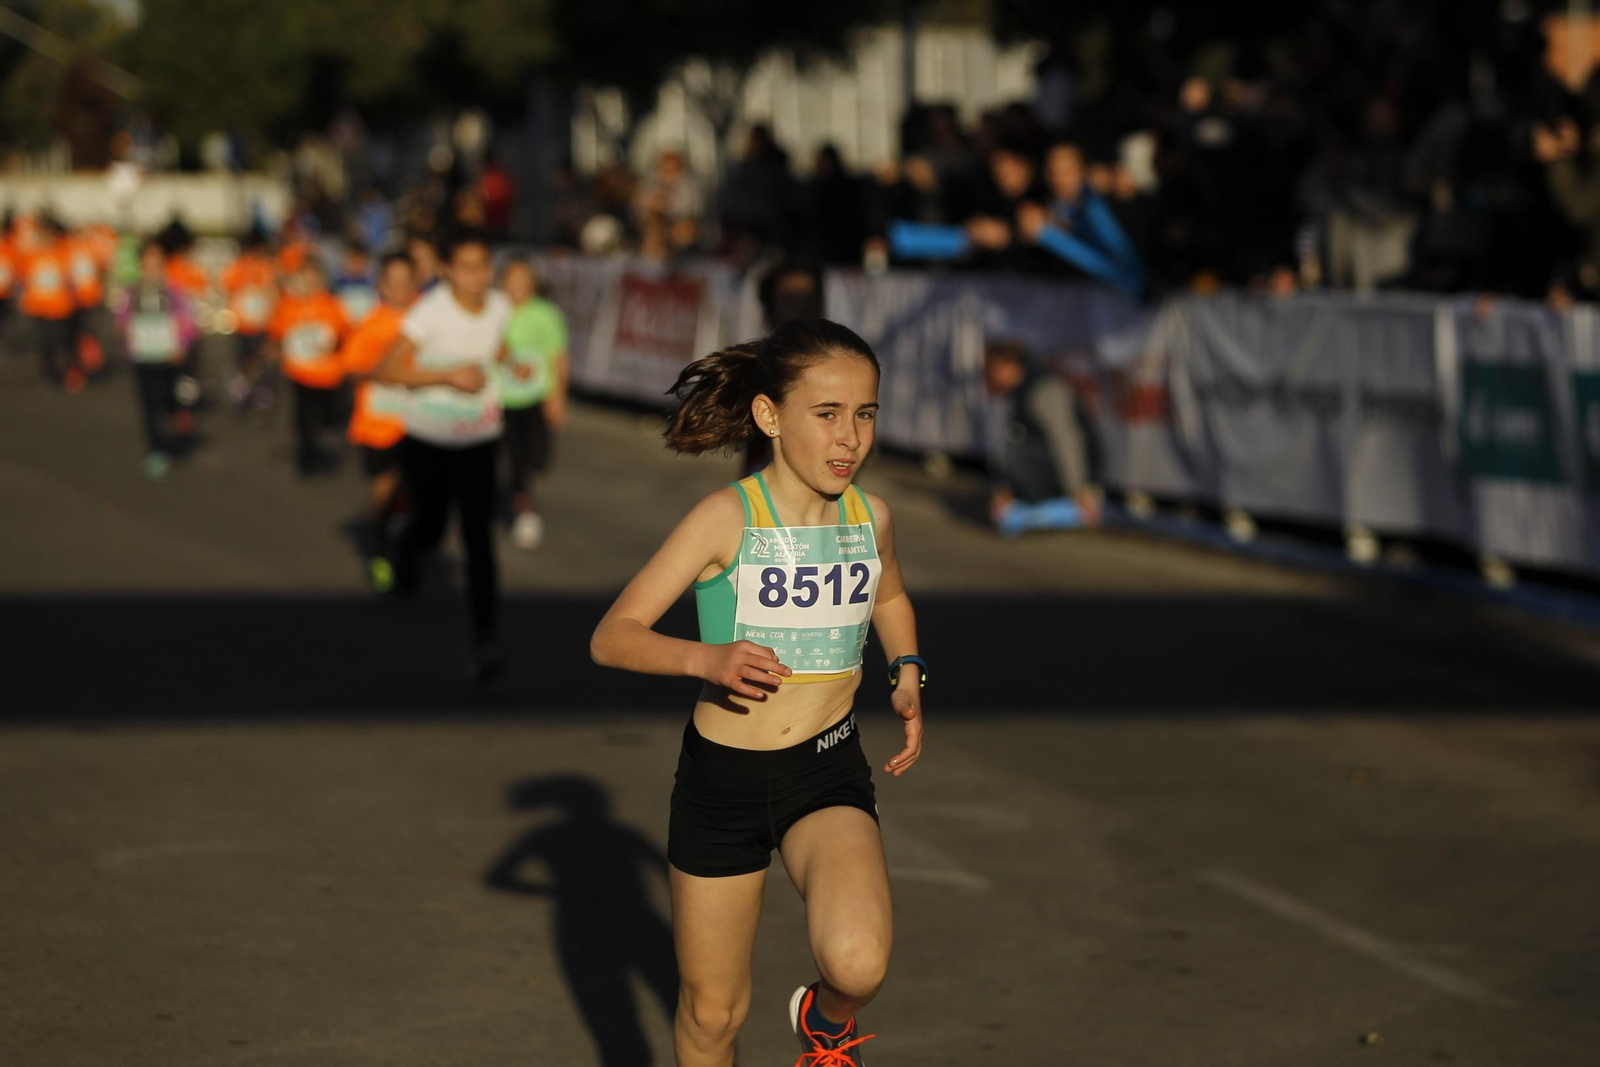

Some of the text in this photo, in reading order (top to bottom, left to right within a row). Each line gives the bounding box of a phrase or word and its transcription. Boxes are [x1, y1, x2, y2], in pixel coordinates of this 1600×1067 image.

[836, 534, 865, 543] CARRERA
[774, 550, 806, 558] ALRÍA
[838, 545, 868, 555] INFANTIL
[758, 562, 870, 608] 8512
[745, 630, 765, 639] NEXA
[816, 720, 851, 754] NIKE
